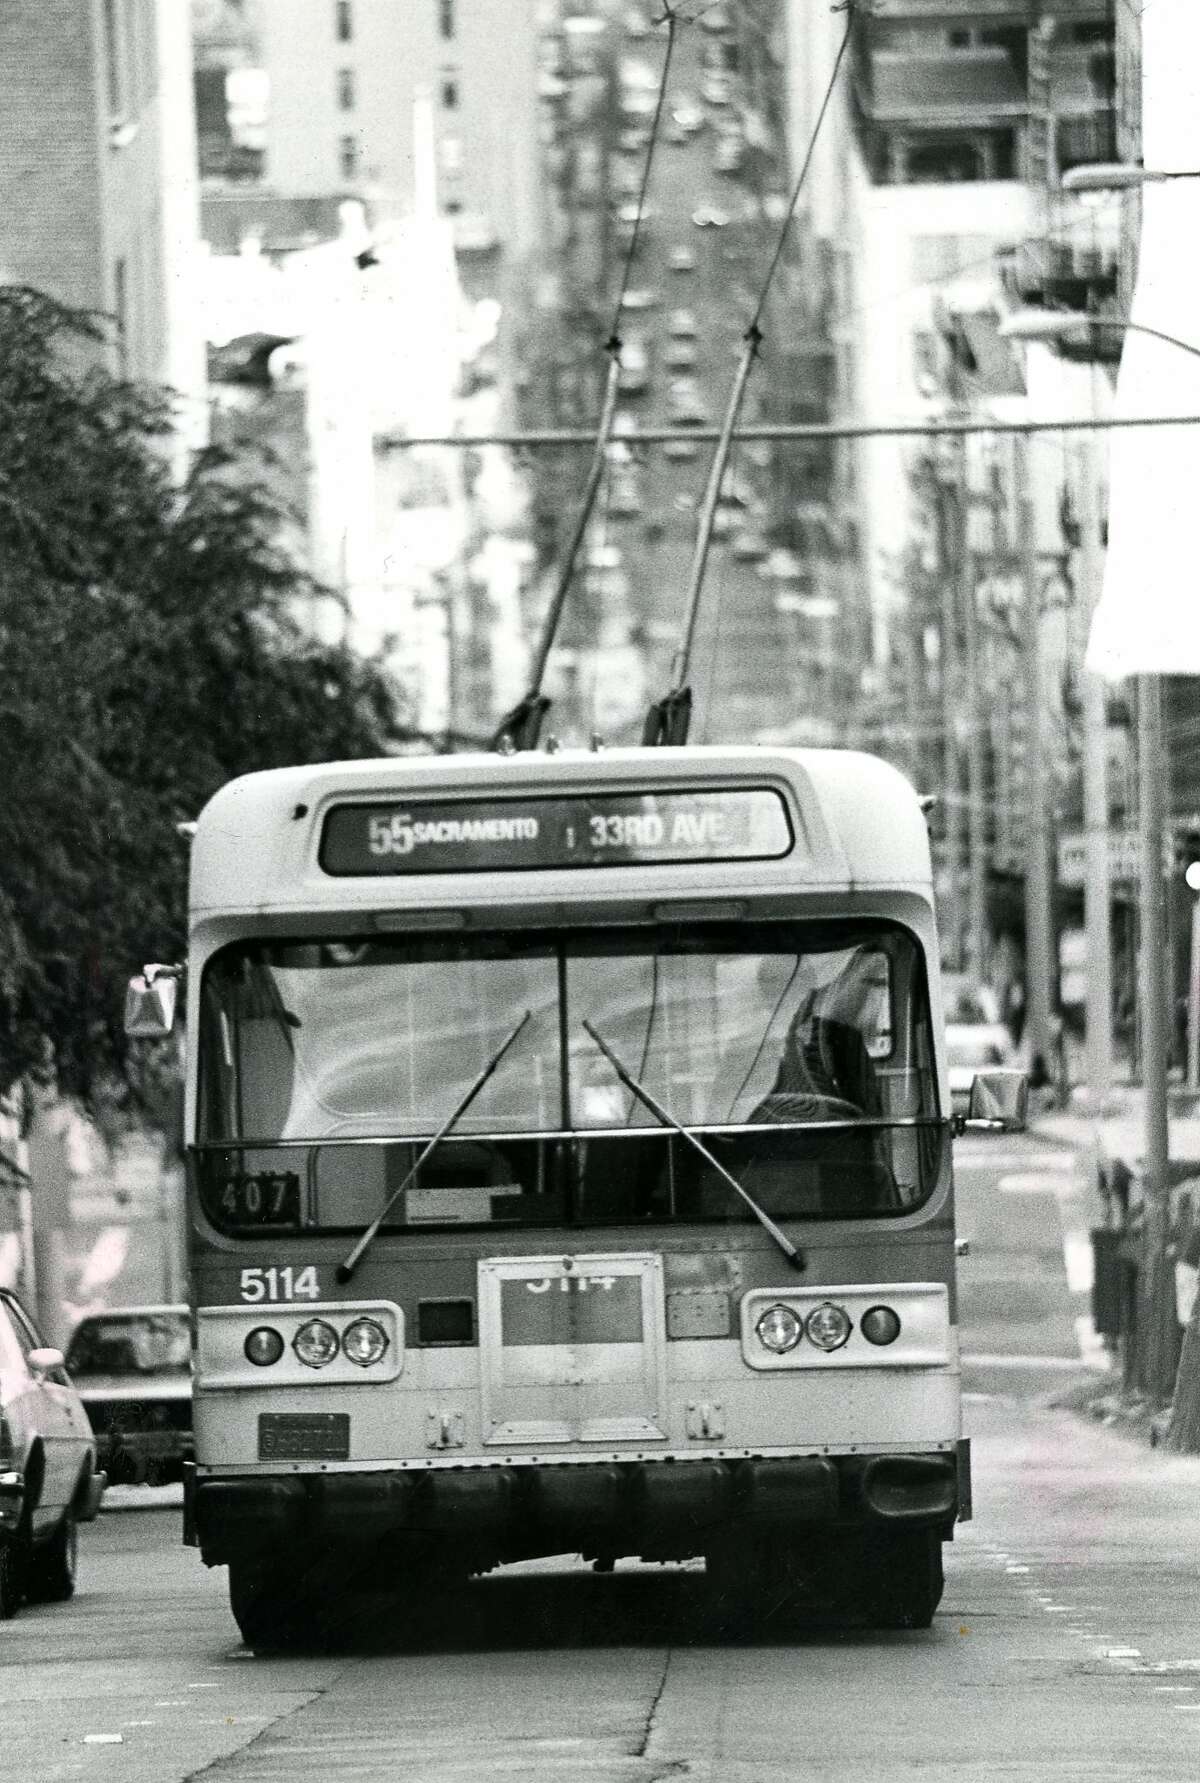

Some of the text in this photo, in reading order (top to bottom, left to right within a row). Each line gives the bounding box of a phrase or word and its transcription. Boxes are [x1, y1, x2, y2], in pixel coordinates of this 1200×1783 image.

[369, 811, 724, 855] 55 SACRAMENTO 33RD AVE
[222, 1181, 286, 1213] 407
[241, 1266, 320, 1302] 5114
